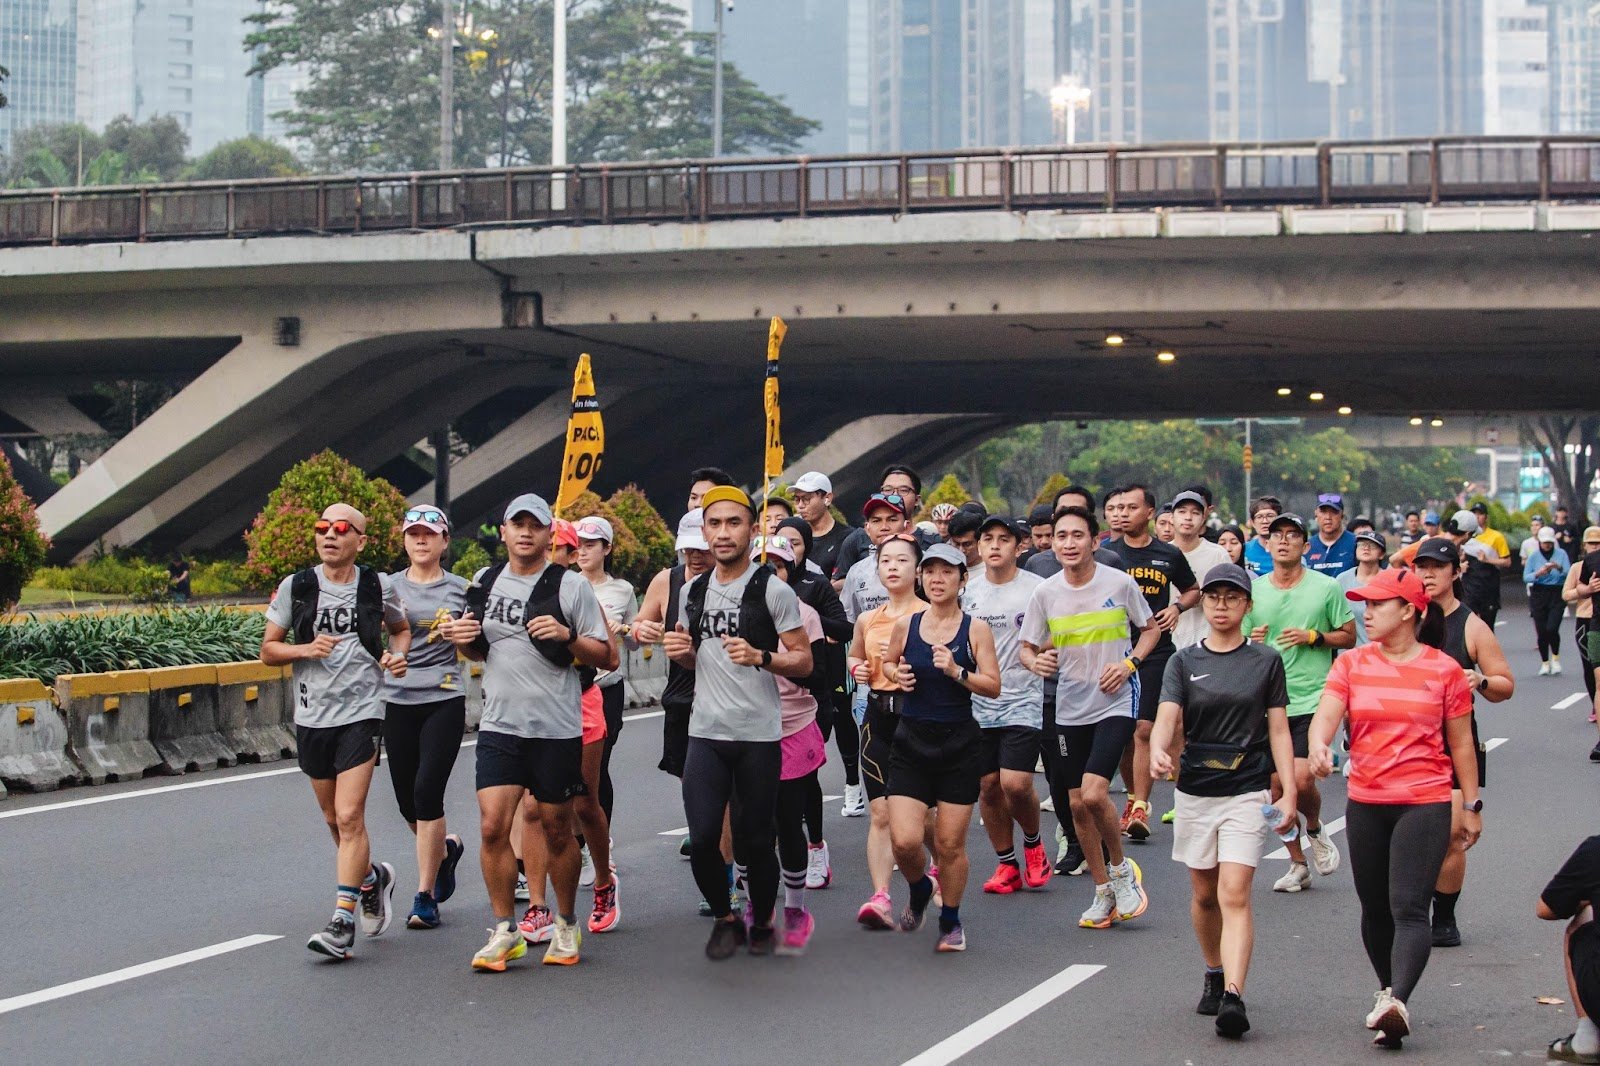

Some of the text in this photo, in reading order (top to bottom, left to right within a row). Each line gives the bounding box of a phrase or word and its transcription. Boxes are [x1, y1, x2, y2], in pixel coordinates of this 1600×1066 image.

[865, 594, 890, 603] Mayban
[317, 607, 358, 633] ACE
[700, 610, 738, 638] ACE
